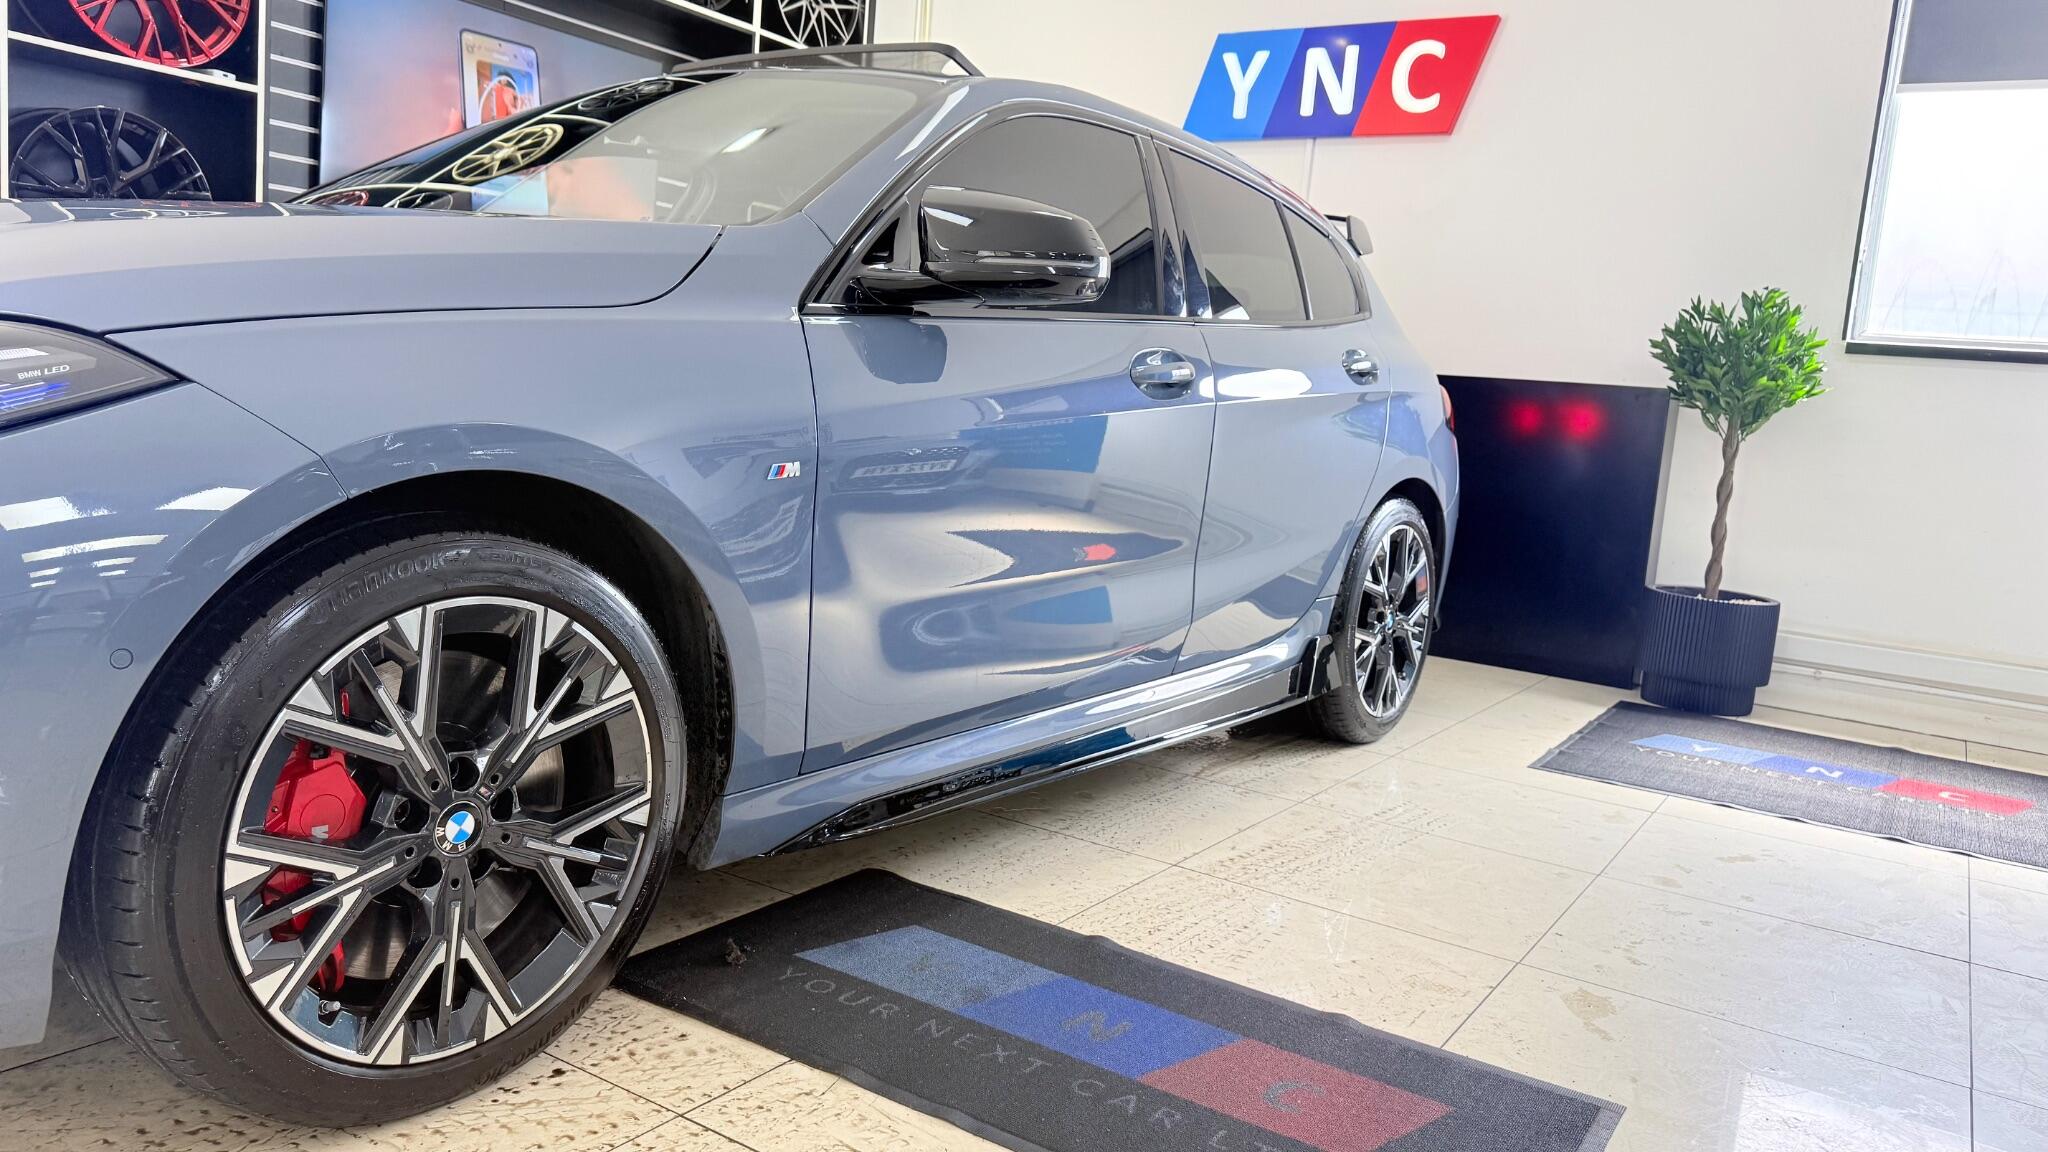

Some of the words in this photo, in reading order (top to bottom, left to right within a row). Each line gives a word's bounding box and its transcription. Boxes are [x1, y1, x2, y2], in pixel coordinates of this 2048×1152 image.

[1222, 39, 1446, 119] YNC
[17, 369, 41, 380] BMW
[44, 364, 70, 375] LED
[1637, 746, 1721, 766] YOUR
[779, 967, 900, 1019] YOUR
[914, 1018, 1051, 1073] NEXT
[1072, 1078, 1183, 1129] CAR
